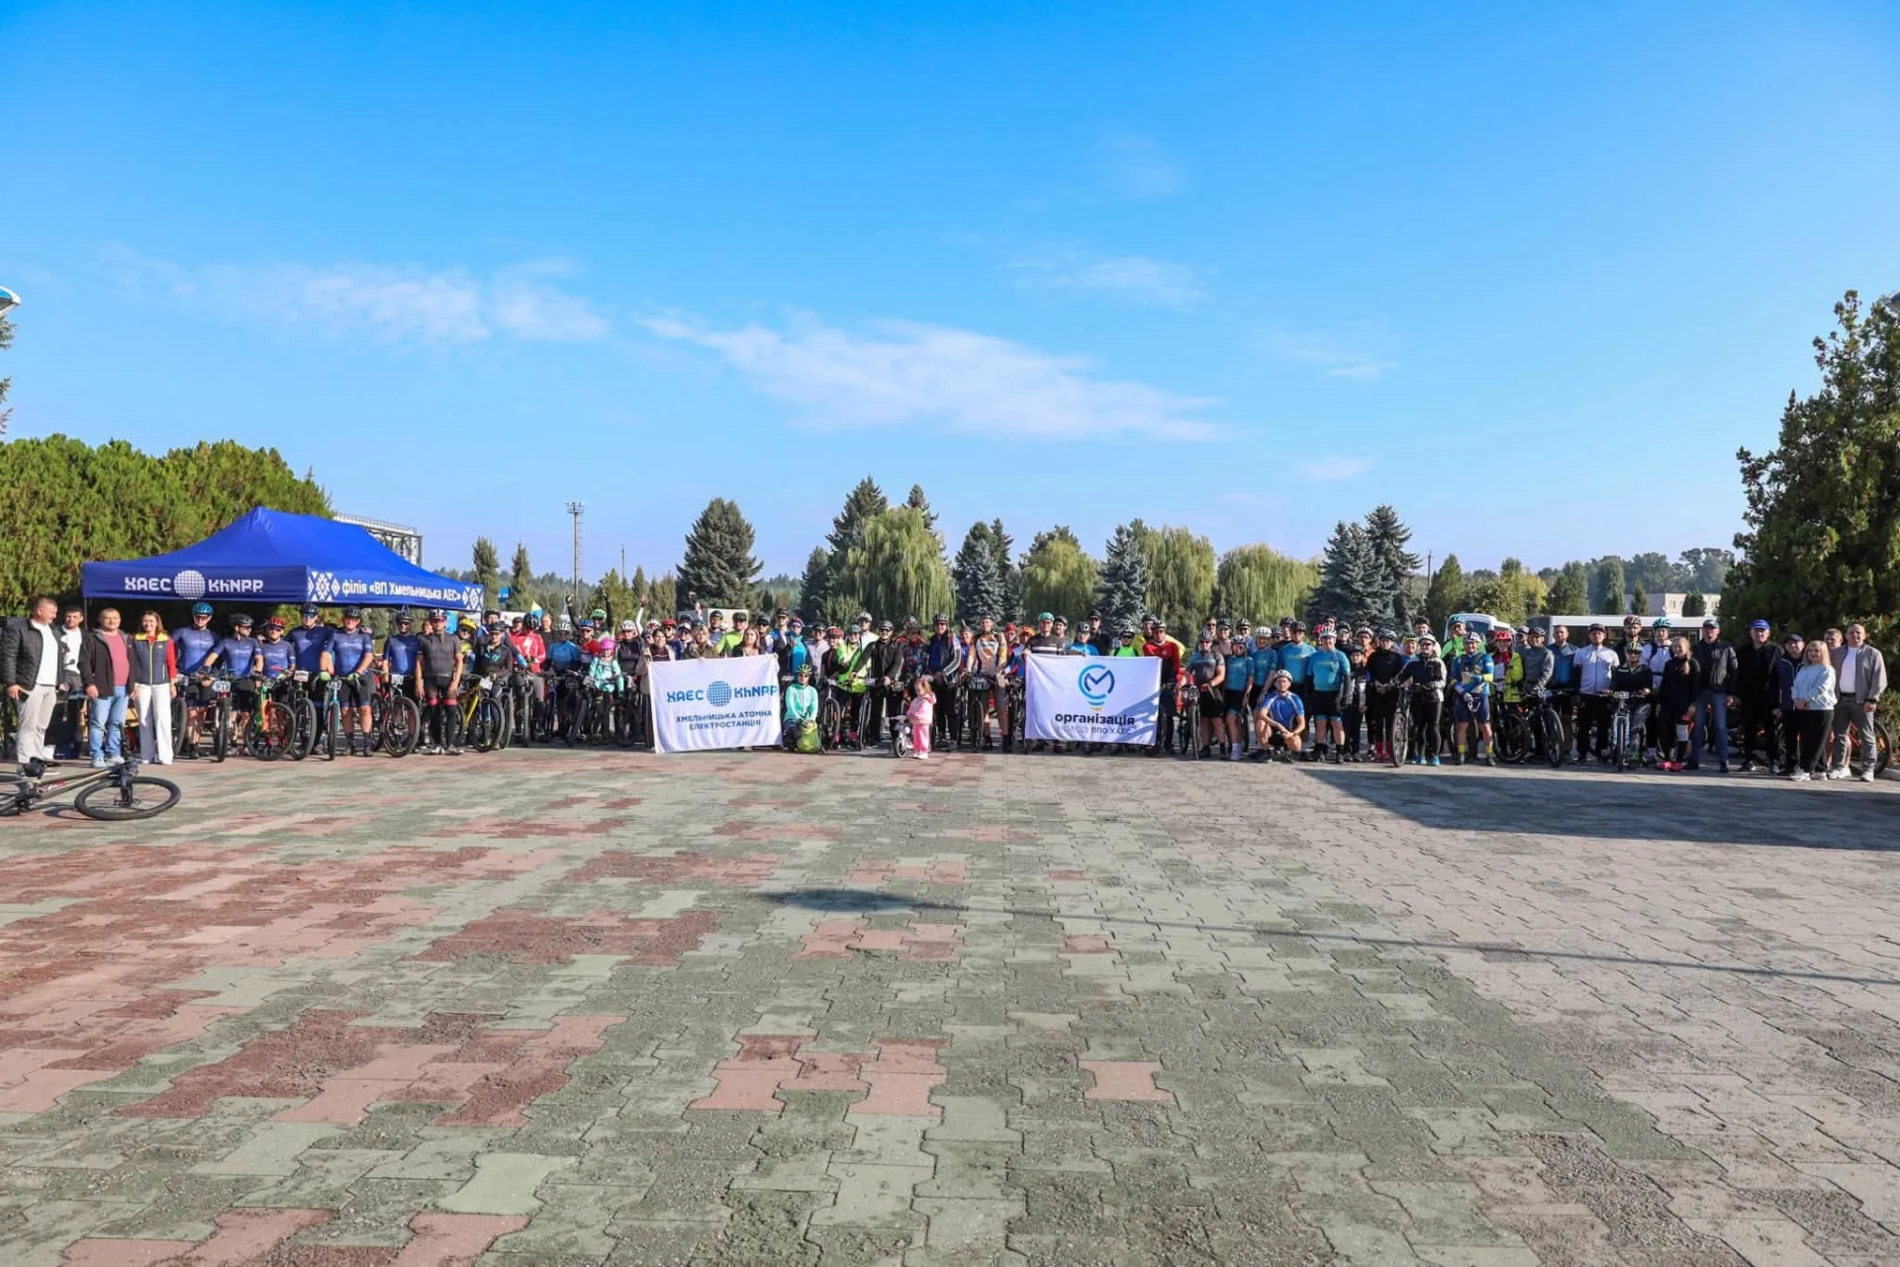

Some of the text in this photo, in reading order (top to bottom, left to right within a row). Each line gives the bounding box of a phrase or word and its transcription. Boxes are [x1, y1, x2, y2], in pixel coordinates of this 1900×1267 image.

[124, 576, 171, 591] ХАЕС
[208, 579, 263, 593] KhNPP
[342, 579, 461, 602] філія «ВП Хмельницька АЕС»
[667, 689, 704, 703] ХАЕС
[676, 710, 773, 723] ХМЕЛЬНИЦЬКА АТОМНА
[1055, 713, 1135, 726] організація
[689, 719, 761, 731] ЕЛЕКТРОСТАНЦІЯ
